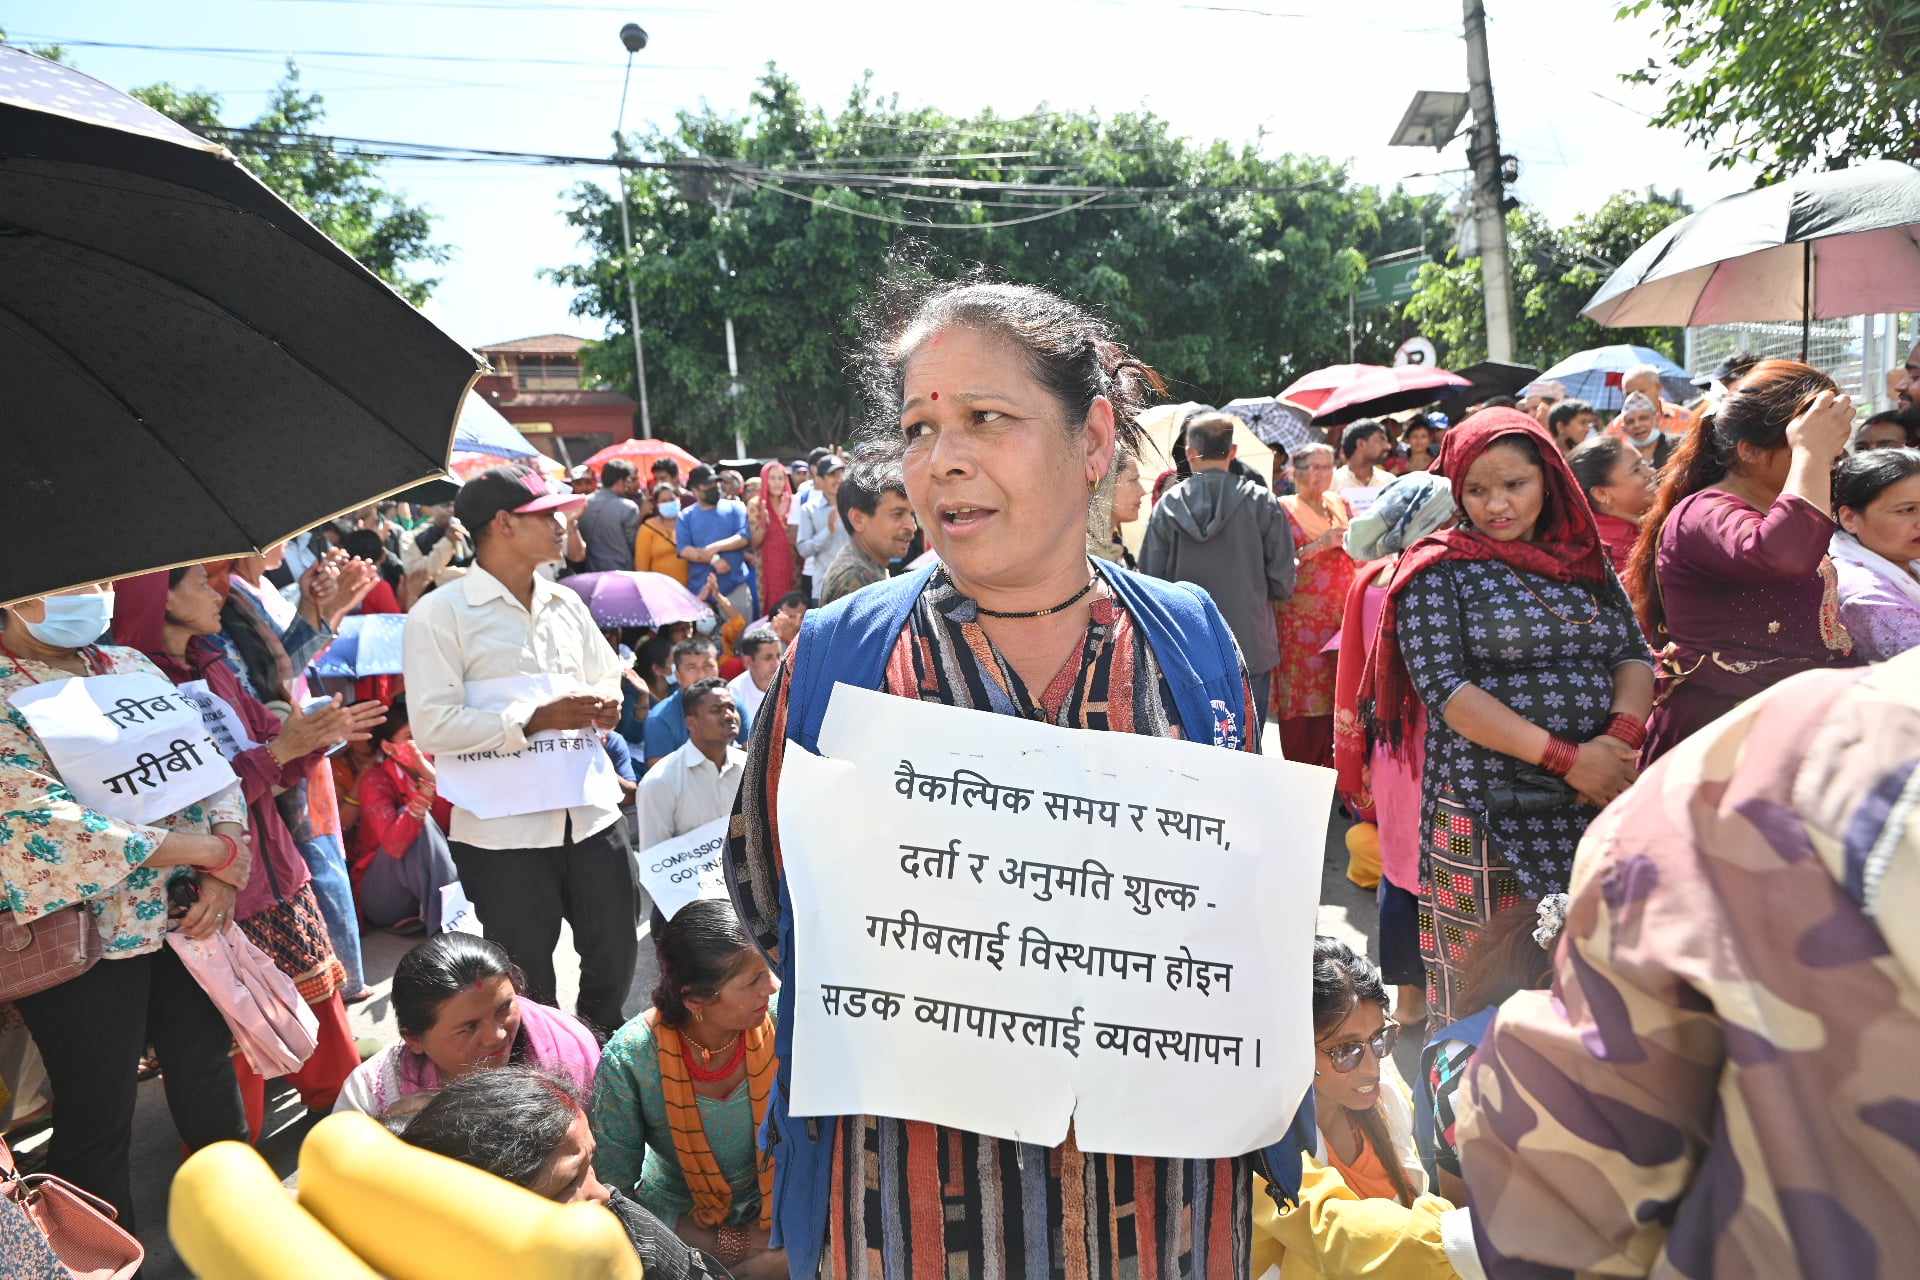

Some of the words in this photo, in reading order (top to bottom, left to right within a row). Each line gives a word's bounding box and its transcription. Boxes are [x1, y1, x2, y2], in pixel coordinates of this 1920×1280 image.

[102, 739, 204, 796] गरीबी
[894, 759, 1035, 814] वैकल्पिक
[1042, 791, 1121, 828] समय
[1127, 803, 1148, 833] र
[1155, 807, 1231, 851] स्थान,
[670, 857, 722, 884] GOVRN
[899, 838, 962, 880] दर्ता
[967, 853, 990, 884] र
[998, 858, 1115, 902] अनुमति
[1122, 874, 1200, 916] शुल्क
[865, 909, 1010, 972] गरीबलाई
[1018, 926, 1157, 983] विस्थापन
[1164, 945, 1234, 998] होइन
[820, 983, 906, 1021] सडक
[913, 996, 1086, 1058] व्यापारलाई
[1093, 1022, 1244, 1067] व्यवस्थापन
